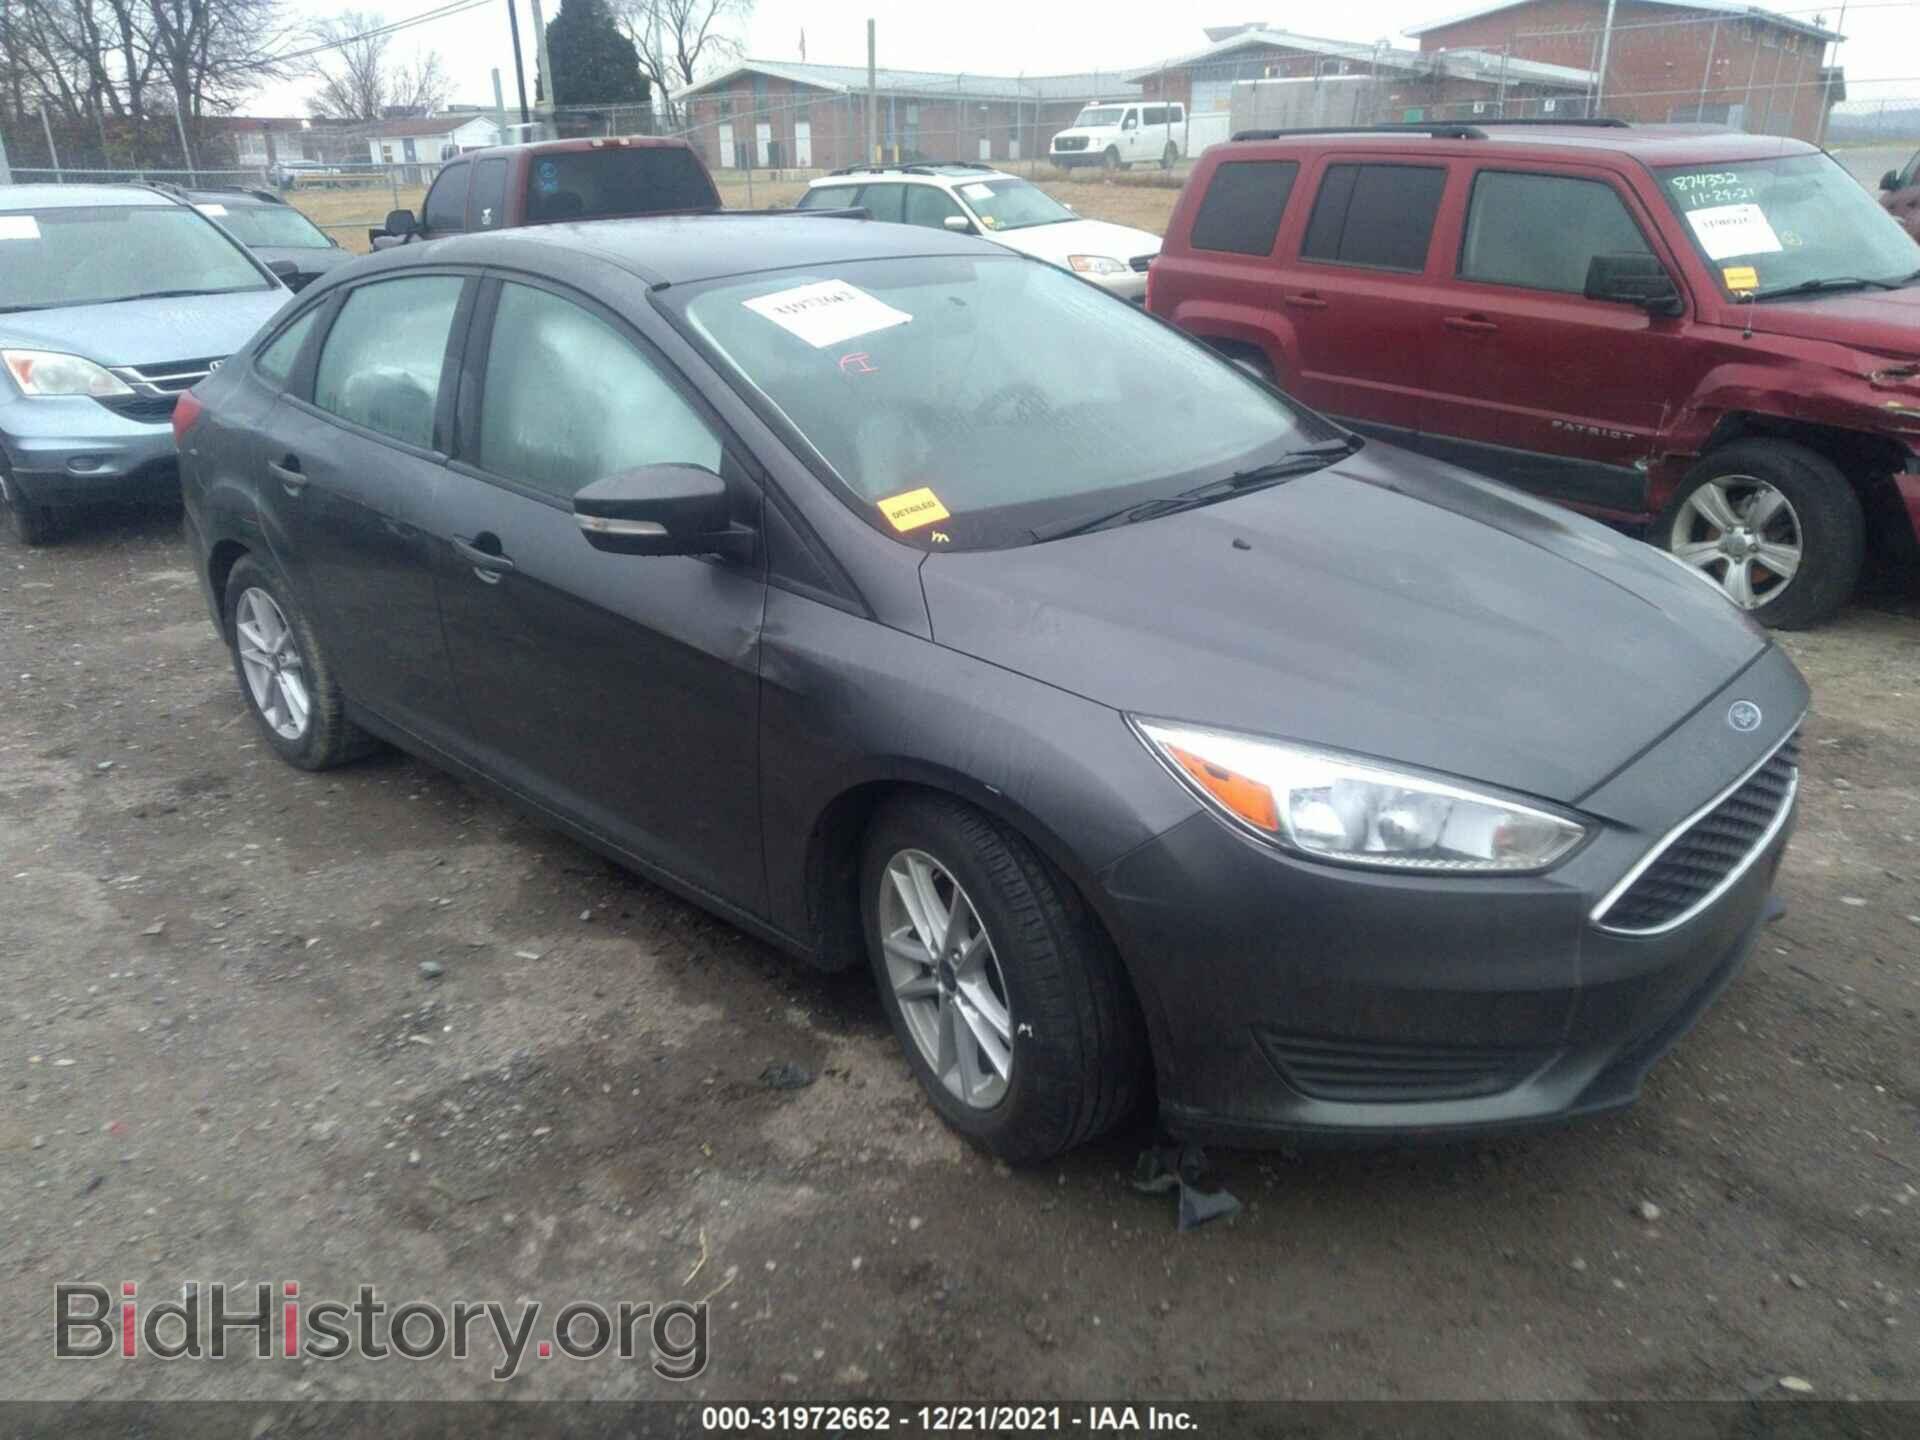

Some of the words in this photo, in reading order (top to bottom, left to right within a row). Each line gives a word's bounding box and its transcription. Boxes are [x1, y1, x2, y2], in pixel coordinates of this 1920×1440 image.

[1672, 171, 1737, 190] 874352
[1552, 420, 1635, 439] PATRIOT
[891, 501, 936, 519] DETAILED
